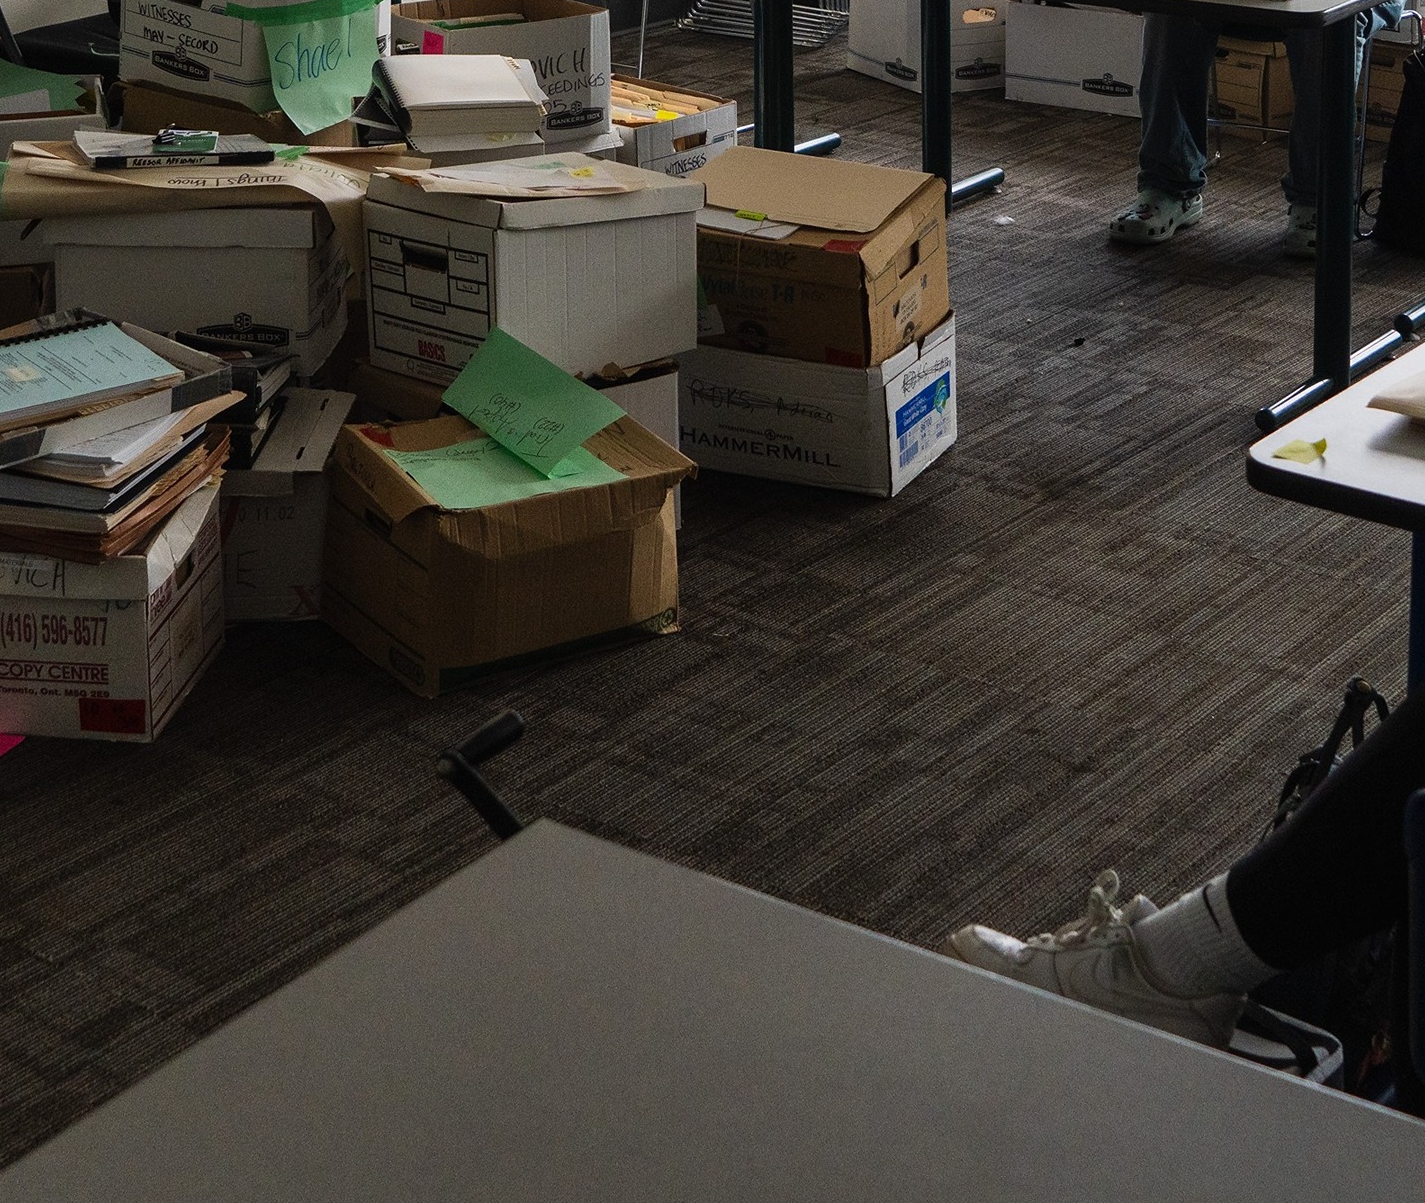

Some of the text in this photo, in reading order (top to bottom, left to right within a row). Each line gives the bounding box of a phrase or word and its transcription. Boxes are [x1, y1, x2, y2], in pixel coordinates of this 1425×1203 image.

[138, 1, 192, 28] WITNESSES
[143, 25, 218, 55] MAY SECORD
[154, 53, 206, 78] BANKERS BOX
[958, 68, 984, 77] BANKERS
[1084, 83, 1130, 94] BANKERS BOX
[550, 111, 602, 126] BANKERS BOX
[132, 156, 205, 167] REESOR AFFIDAVIT
[664, 153, 708, 175] WITNESSES
[257, 333, 282, 341] BOX
[418, 339, 446, 363] BASICS
[718, 423, 764, 437] INTERNATIONAL
[0, 611, 108, 649] (416) 596-8577
[48, 664, 110, 682] CENTRE
[40, 687, 62, 696] Ont.
